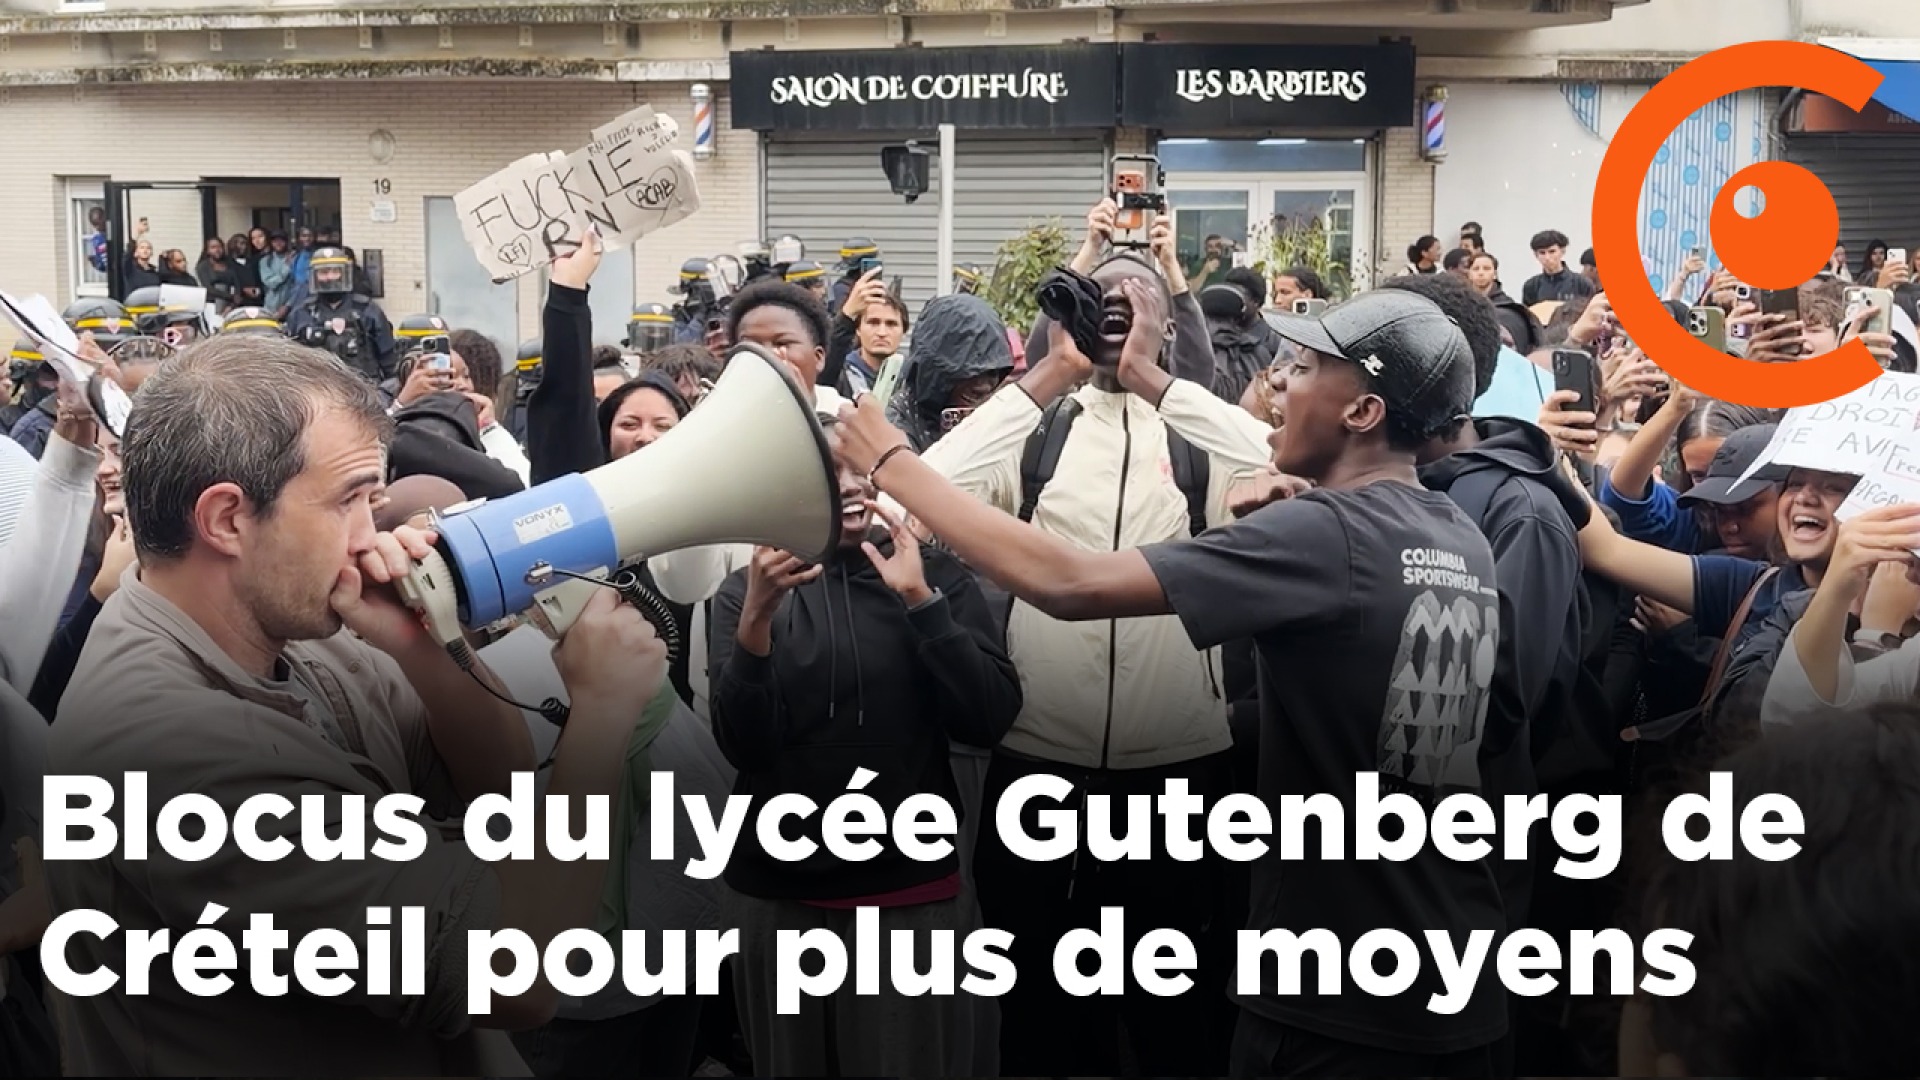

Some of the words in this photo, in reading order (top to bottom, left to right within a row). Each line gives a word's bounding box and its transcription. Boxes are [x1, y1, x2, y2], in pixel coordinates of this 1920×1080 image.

[770, 72, 867, 108] SALON
[867, 74, 908, 101] DE
[911, 67, 1069, 103] COIFFURE
[1175, 69, 1223, 103] LES
[1226, 68, 1367, 103] BARBIERS
[372, 177, 391, 195] 19
[469, 166, 593, 245] FUCK
[588, 138, 644, 198] LE
[635, 178, 676, 207] ACAB
[542, 201, 622, 259] RN
[515, 505, 564, 528] VONYX
[1401, 548, 1468, 573] COLUMBIA
[1403, 566, 1480, 594] SPORTSWEAR
